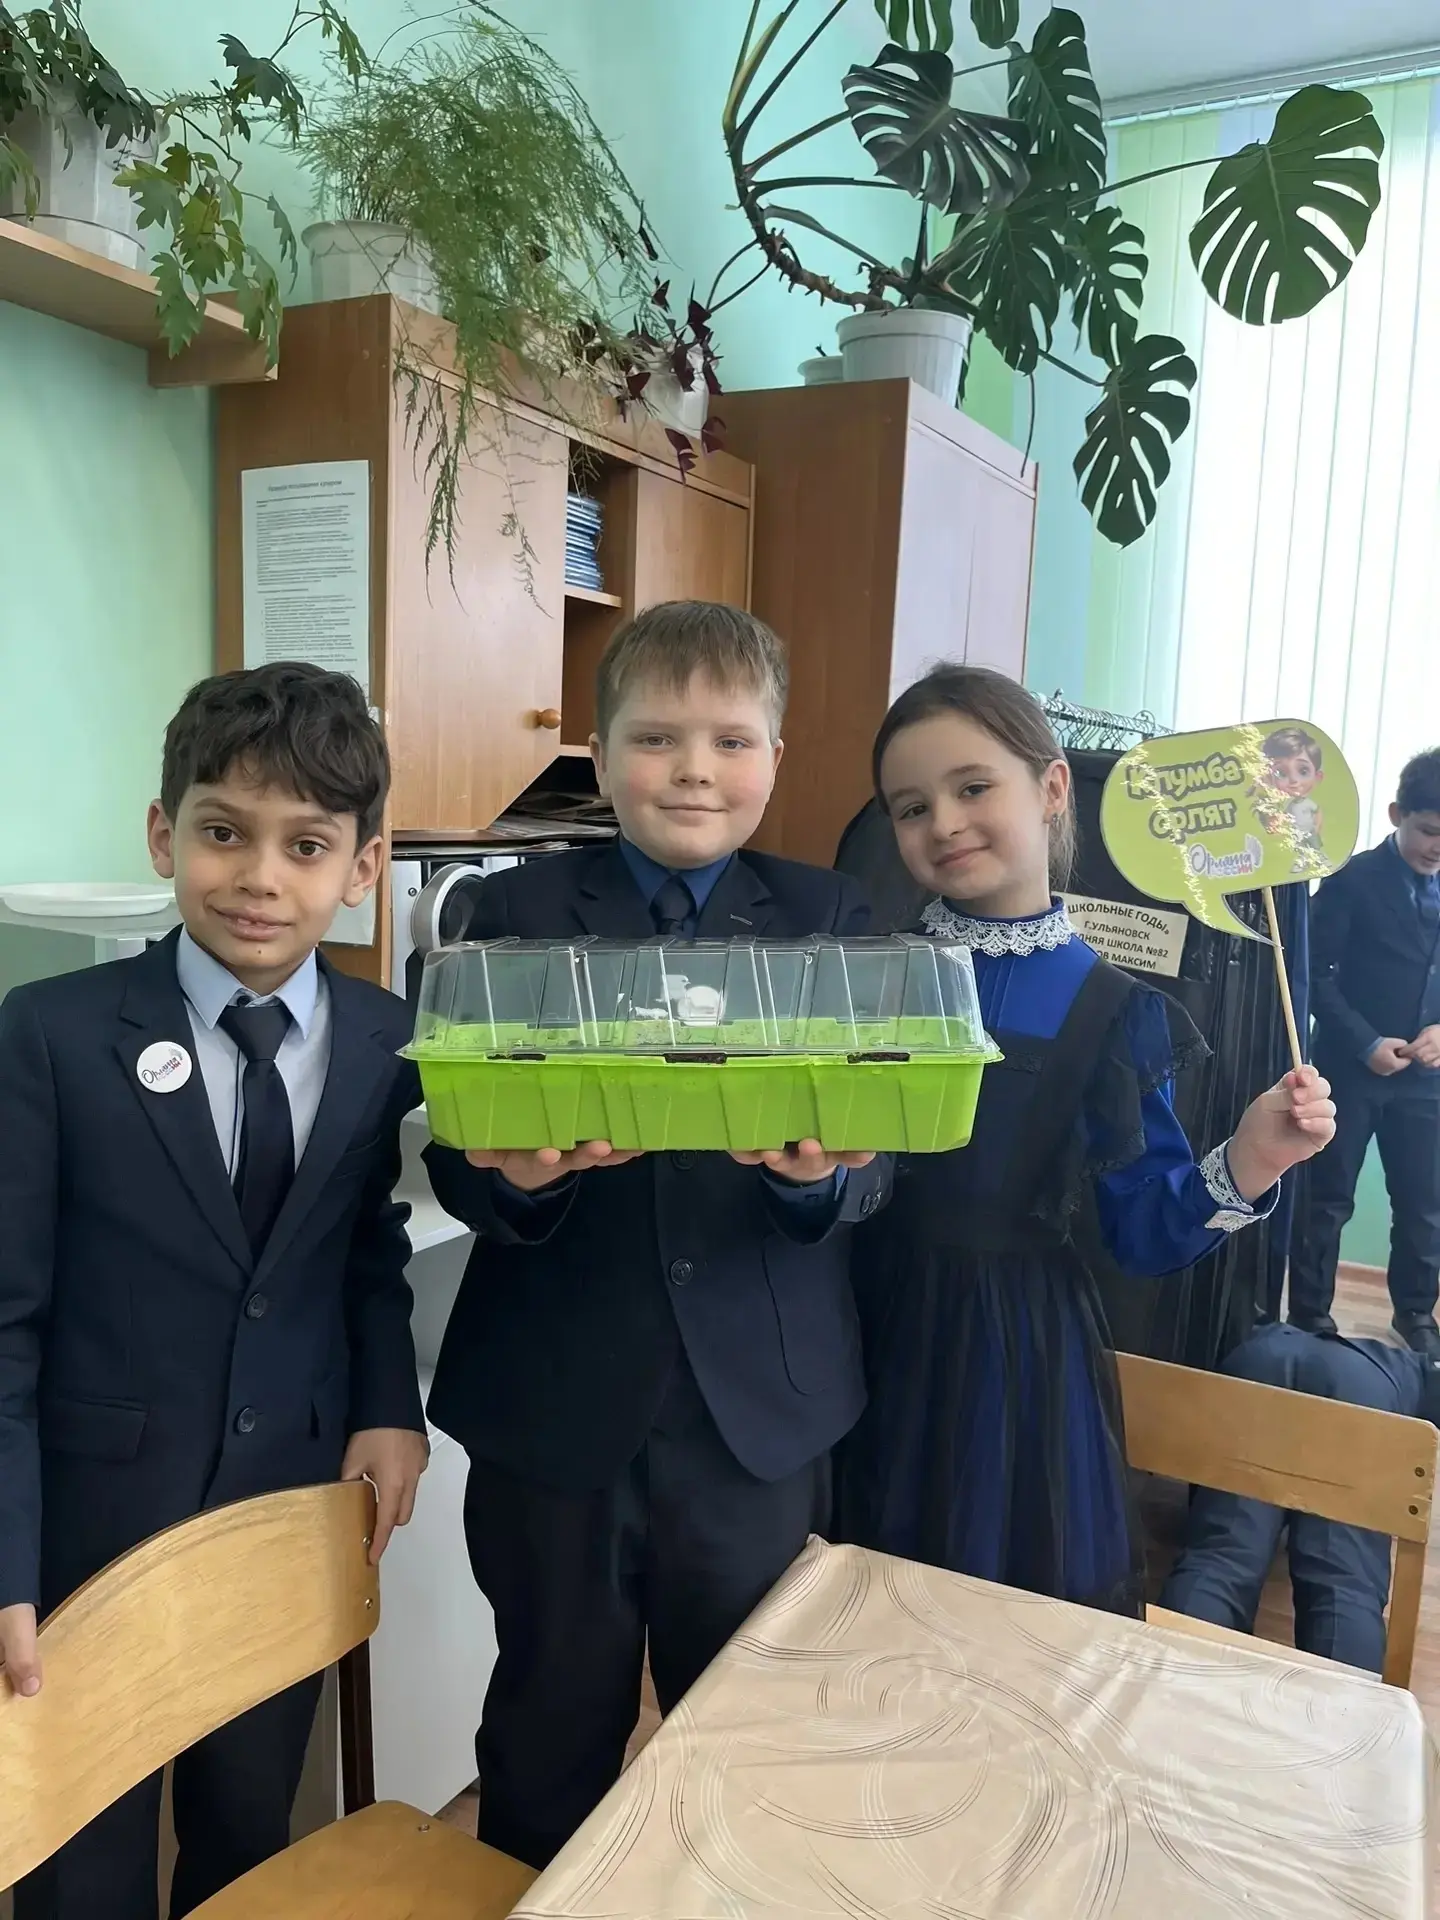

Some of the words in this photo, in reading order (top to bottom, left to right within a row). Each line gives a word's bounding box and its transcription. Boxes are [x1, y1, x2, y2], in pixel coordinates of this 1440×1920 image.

[1127, 753, 1244, 800] Клумба
[1068, 903, 1134, 917] ШКОЛЬНЫЕ
[1076, 932, 1105, 946] ДНЯЯ
[1107, 938, 1143, 953] ШКОЛА
[1145, 946, 1169, 958] №82
[1111, 954, 1156, 970] МАКСИМ
